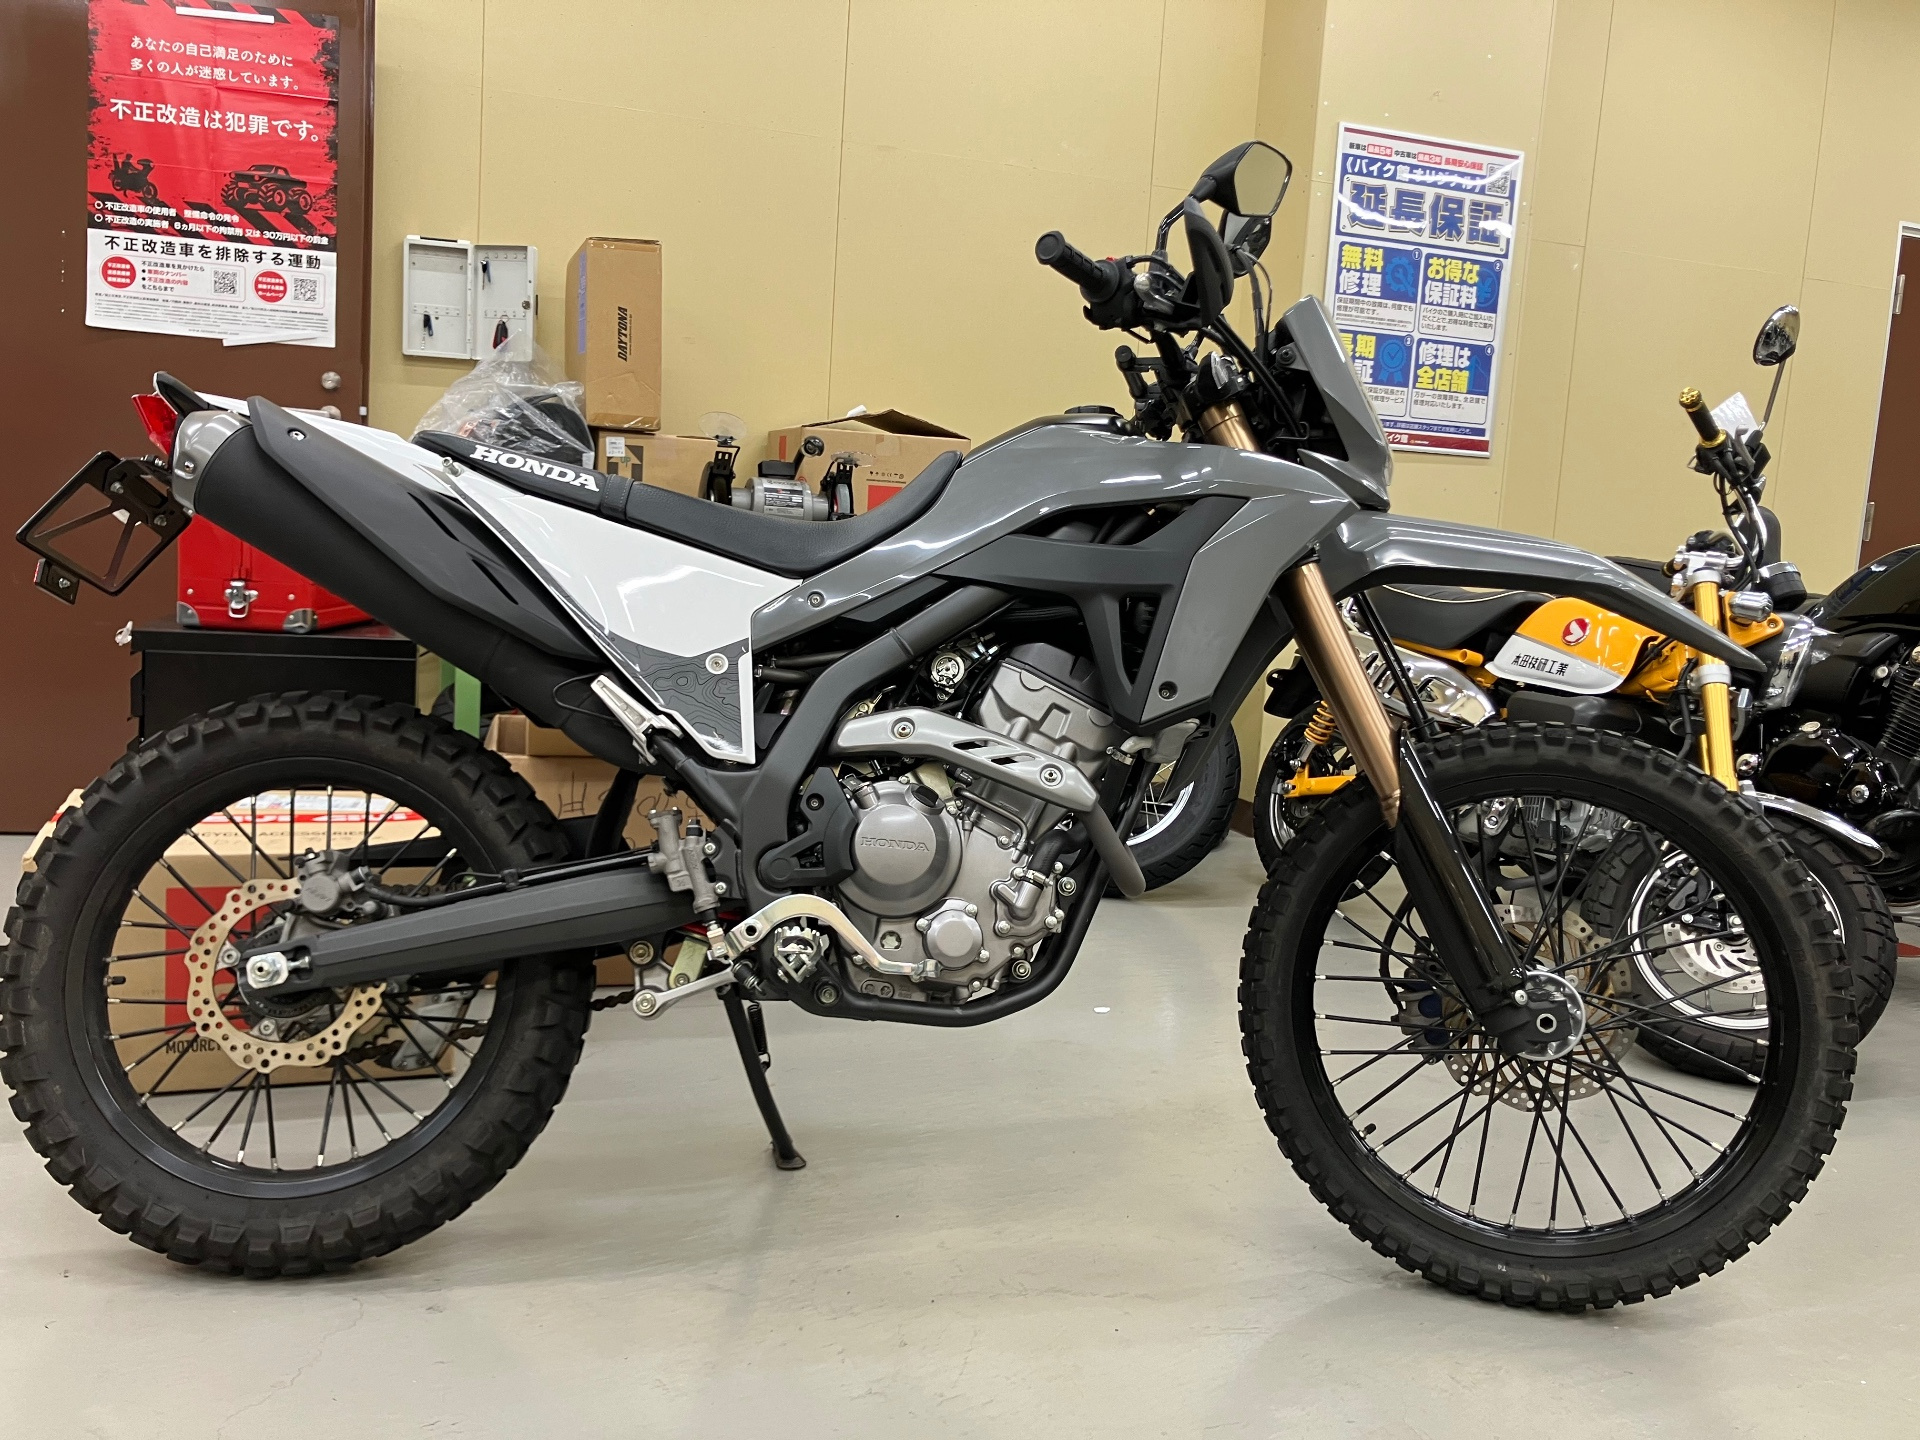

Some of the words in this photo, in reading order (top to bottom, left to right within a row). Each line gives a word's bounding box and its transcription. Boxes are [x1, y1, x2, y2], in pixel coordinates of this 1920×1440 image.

[130, 36, 294, 67] あなたの自己満足のために
[130, 58, 300, 91] 多くの人が迷惑しています。
[110, 98, 319, 142] 不正改造は犯罪です。
[105, 201, 177, 217] 不正改造車の使用者
[1347, 180, 1504, 248] 延長保証
[104, 235, 321, 270] 不正改造車を排除する運動
[1341, 244, 1384, 273] 無料
[1339, 269, 1382, 297] 修理
[1427, 257, 1480, 284] お得な
[1424, 280, 1477, 310] 保証料
[617, 306, 628, 363] DAYTONA
[1418, 341, 1471, 368] 修理は
[1415, 365, 1469, 393] 全店舗
[469, 445, 600, 492] HONDA
[1511, 653, 1569, 677] 本田技研工業
[860, 836, 930, 852] HONDA
